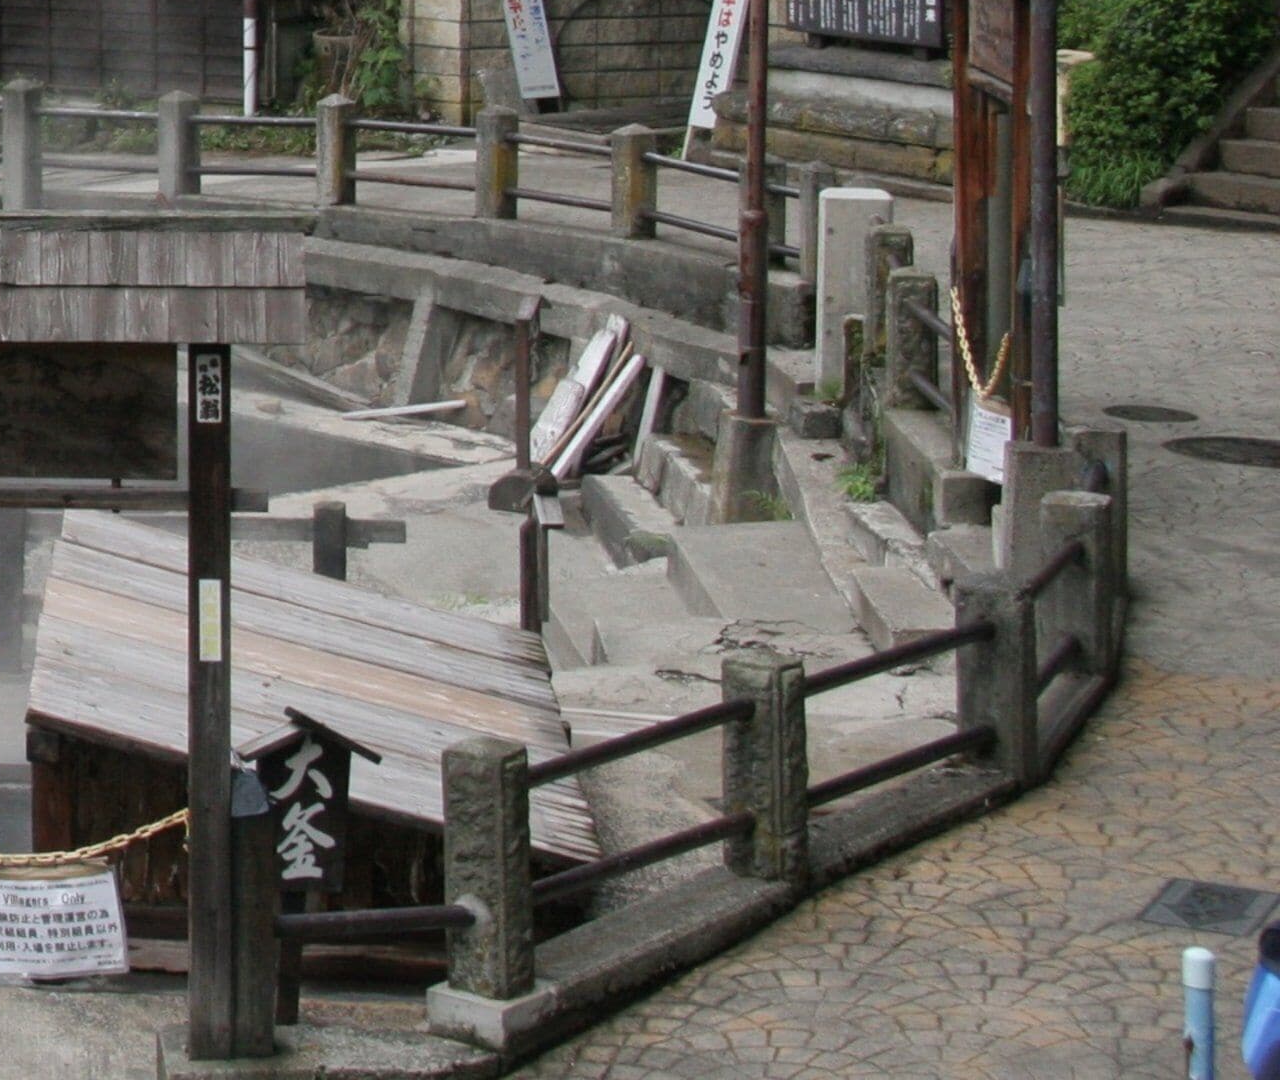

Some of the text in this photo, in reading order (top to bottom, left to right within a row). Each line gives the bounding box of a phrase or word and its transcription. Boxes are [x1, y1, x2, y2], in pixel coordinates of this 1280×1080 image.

[270, 739, 336, 881] 大釜
[1, 891, 86, 907] Villagers Only
